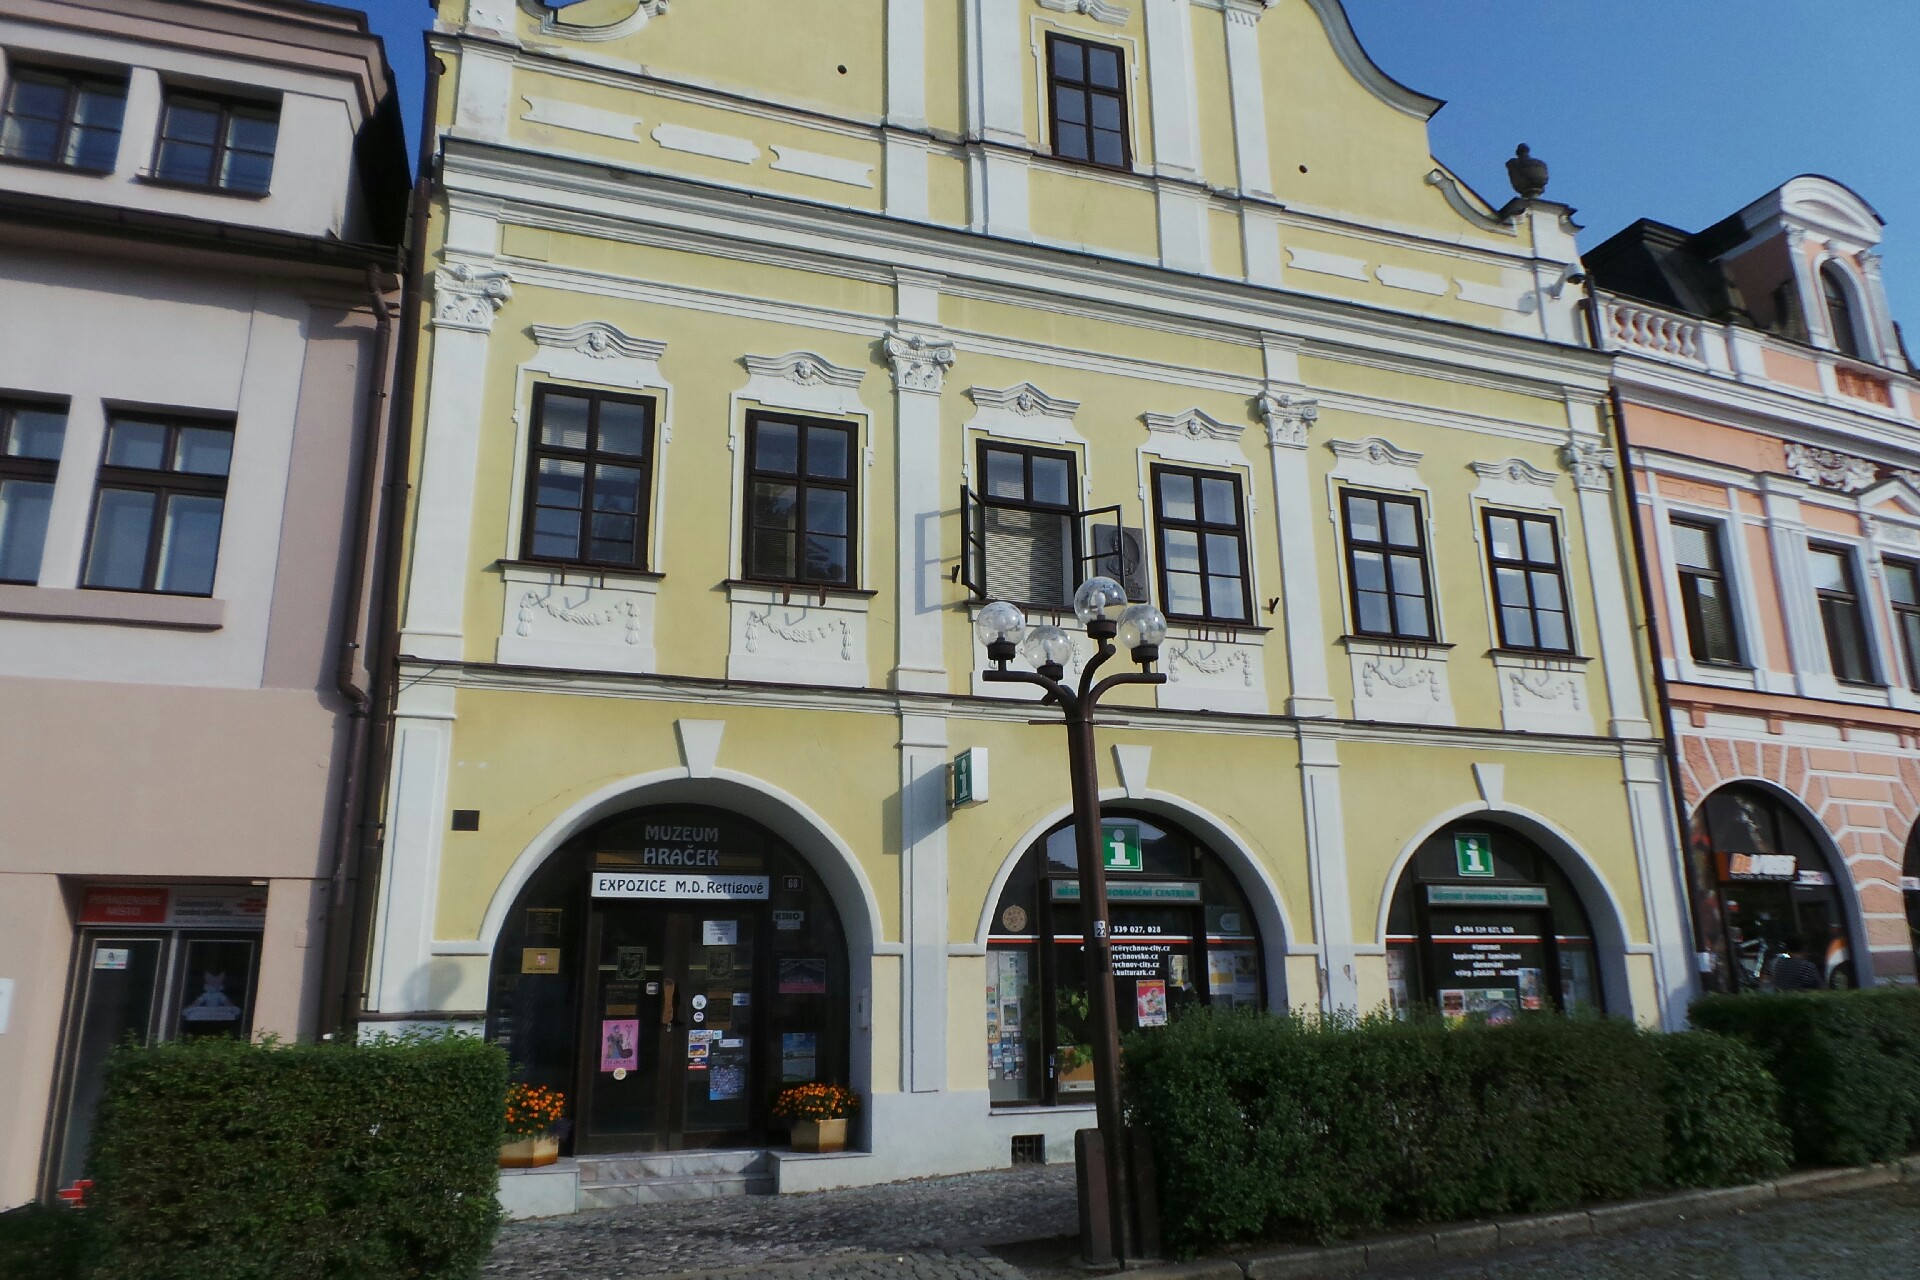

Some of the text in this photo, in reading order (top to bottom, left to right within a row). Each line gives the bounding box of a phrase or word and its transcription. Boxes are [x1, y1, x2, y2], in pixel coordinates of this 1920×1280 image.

[645, 825, 719, 842] MUZEUM
[643, 844, 719, 866] HRAČEK
[599, 878, 764, 895] EXPOZICE M.D. Rettigové
[1113, 925, 1162, 935] 539 027, 028
[1111, 961, 1160, 969] rychnov-city.cz
